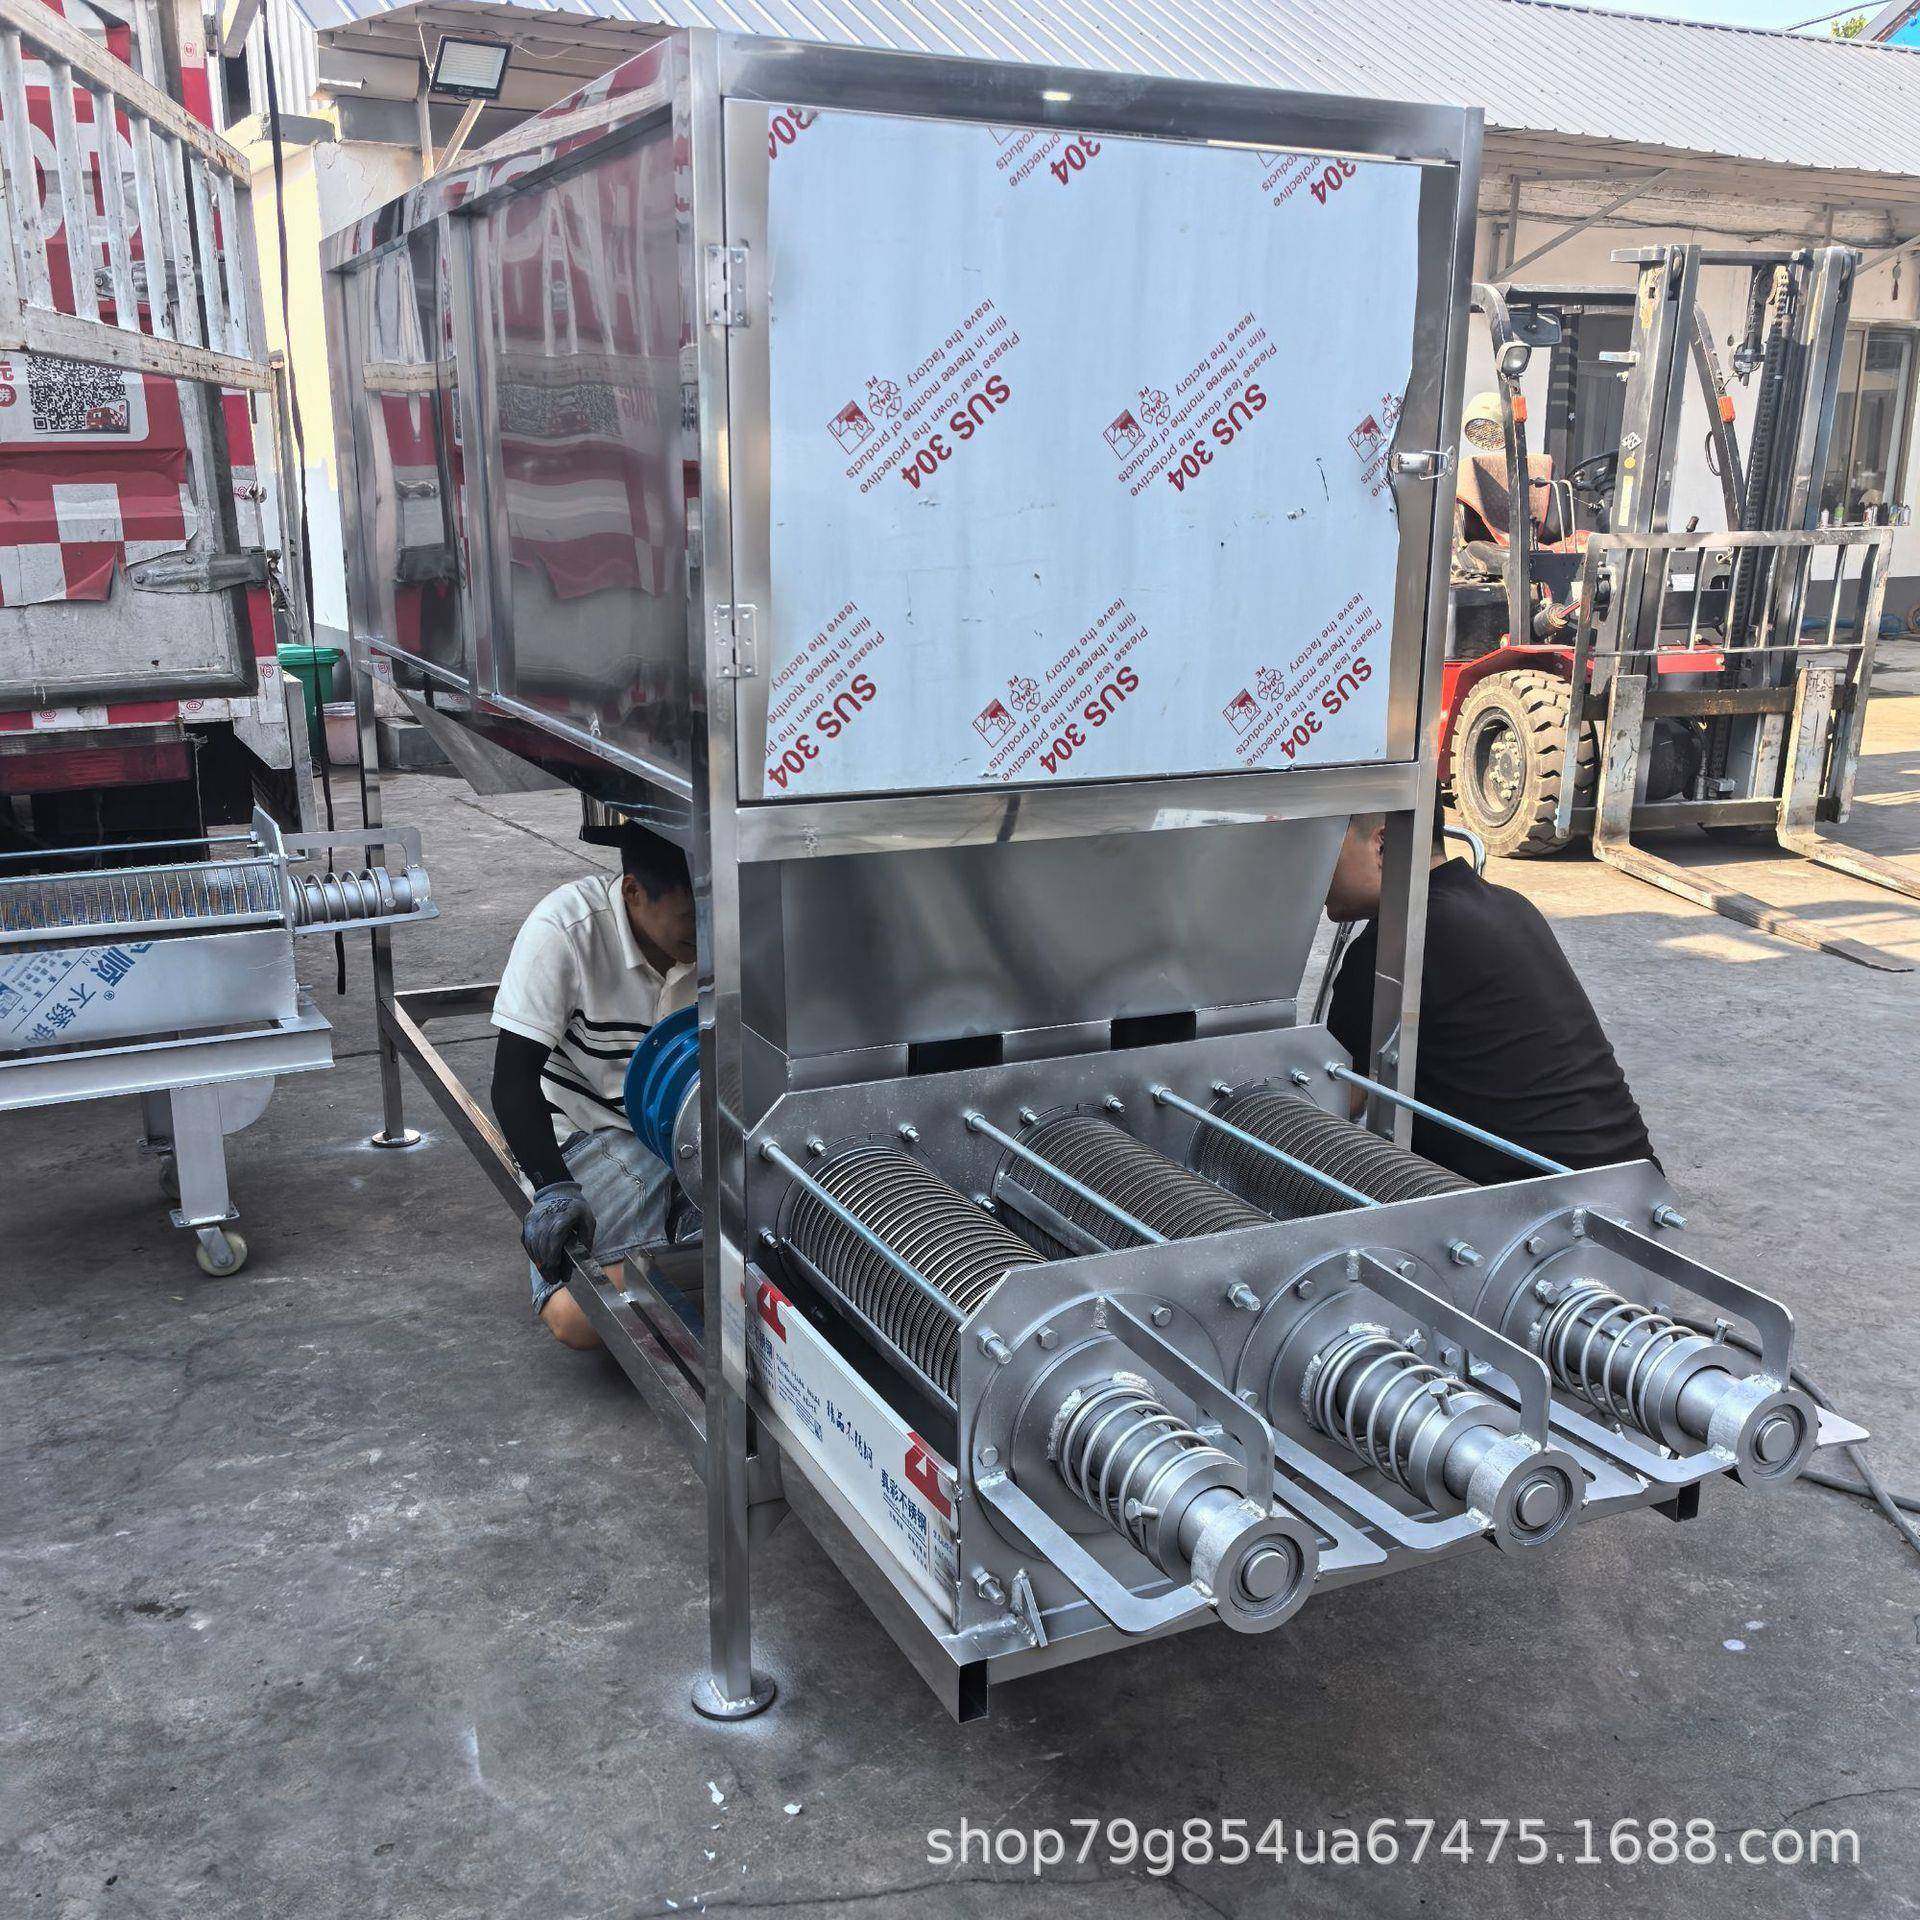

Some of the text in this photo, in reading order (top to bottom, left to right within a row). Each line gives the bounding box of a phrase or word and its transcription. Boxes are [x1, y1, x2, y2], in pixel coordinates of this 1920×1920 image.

[1009, 132, 1058, 186] protective
[1050, 131, 1101, 186] 304
[1310, 157, 1355, 205] 304
[906, 297, 997, 389] leave the factory
[973, 334, 991, 352] in
[985, 315, 1008, 339] film
[1247, 328, 1266, 350] film
[1176, 312, 1256, 398] leave the factory
[1233, 347, 1249, 359] in
[858, 329, 1022, 495] Please tear down the protective
[889, 419, 904, 437] of
[900, 375, 1013, 489] SUS 304
[1127, 342, 1279, 497] Please tear down the protective
[1159, 426, 1172, 443] of
[846, 430, 895, 480] products
[1115, 437, 1160, 486] products
[1167, 384, 1272, 494] SUS 304
[849, 616, 872, 638] film
[1044, 597, 1127, 684] leave the factory
[1105, 631, 1122, 646] in
[1114, 612, 1136, 632] film
[1288, 592, 1366, 674] leave the factory
[1344, 624, 1358, 638] in
[1353, 606, 1375, 628] film
[766, 601, 859, 691] leave the factory
[835, 637, 852, 650] in
[846, 631, 887, 670] Please
[826, 669, 848, 694] tear
[1001, 625, 1150, 782] Please tear down the protective
[1246, 618, 1384, 766] Please tear down the protective
[768, 673, 877, 788] SUS 304
[793, 693, 824, 722] down
[1028, 712, 1041, 730] of
[1036, 666, 1141, 775] SUS 304
[1271, 701, 1287, 717] of
[1280, 655, 1373, 760] SUS 304
[776, 722, 797, 742] the
[987, 722, 1032, 771] products
[1234, 711, 1278, 757] products
